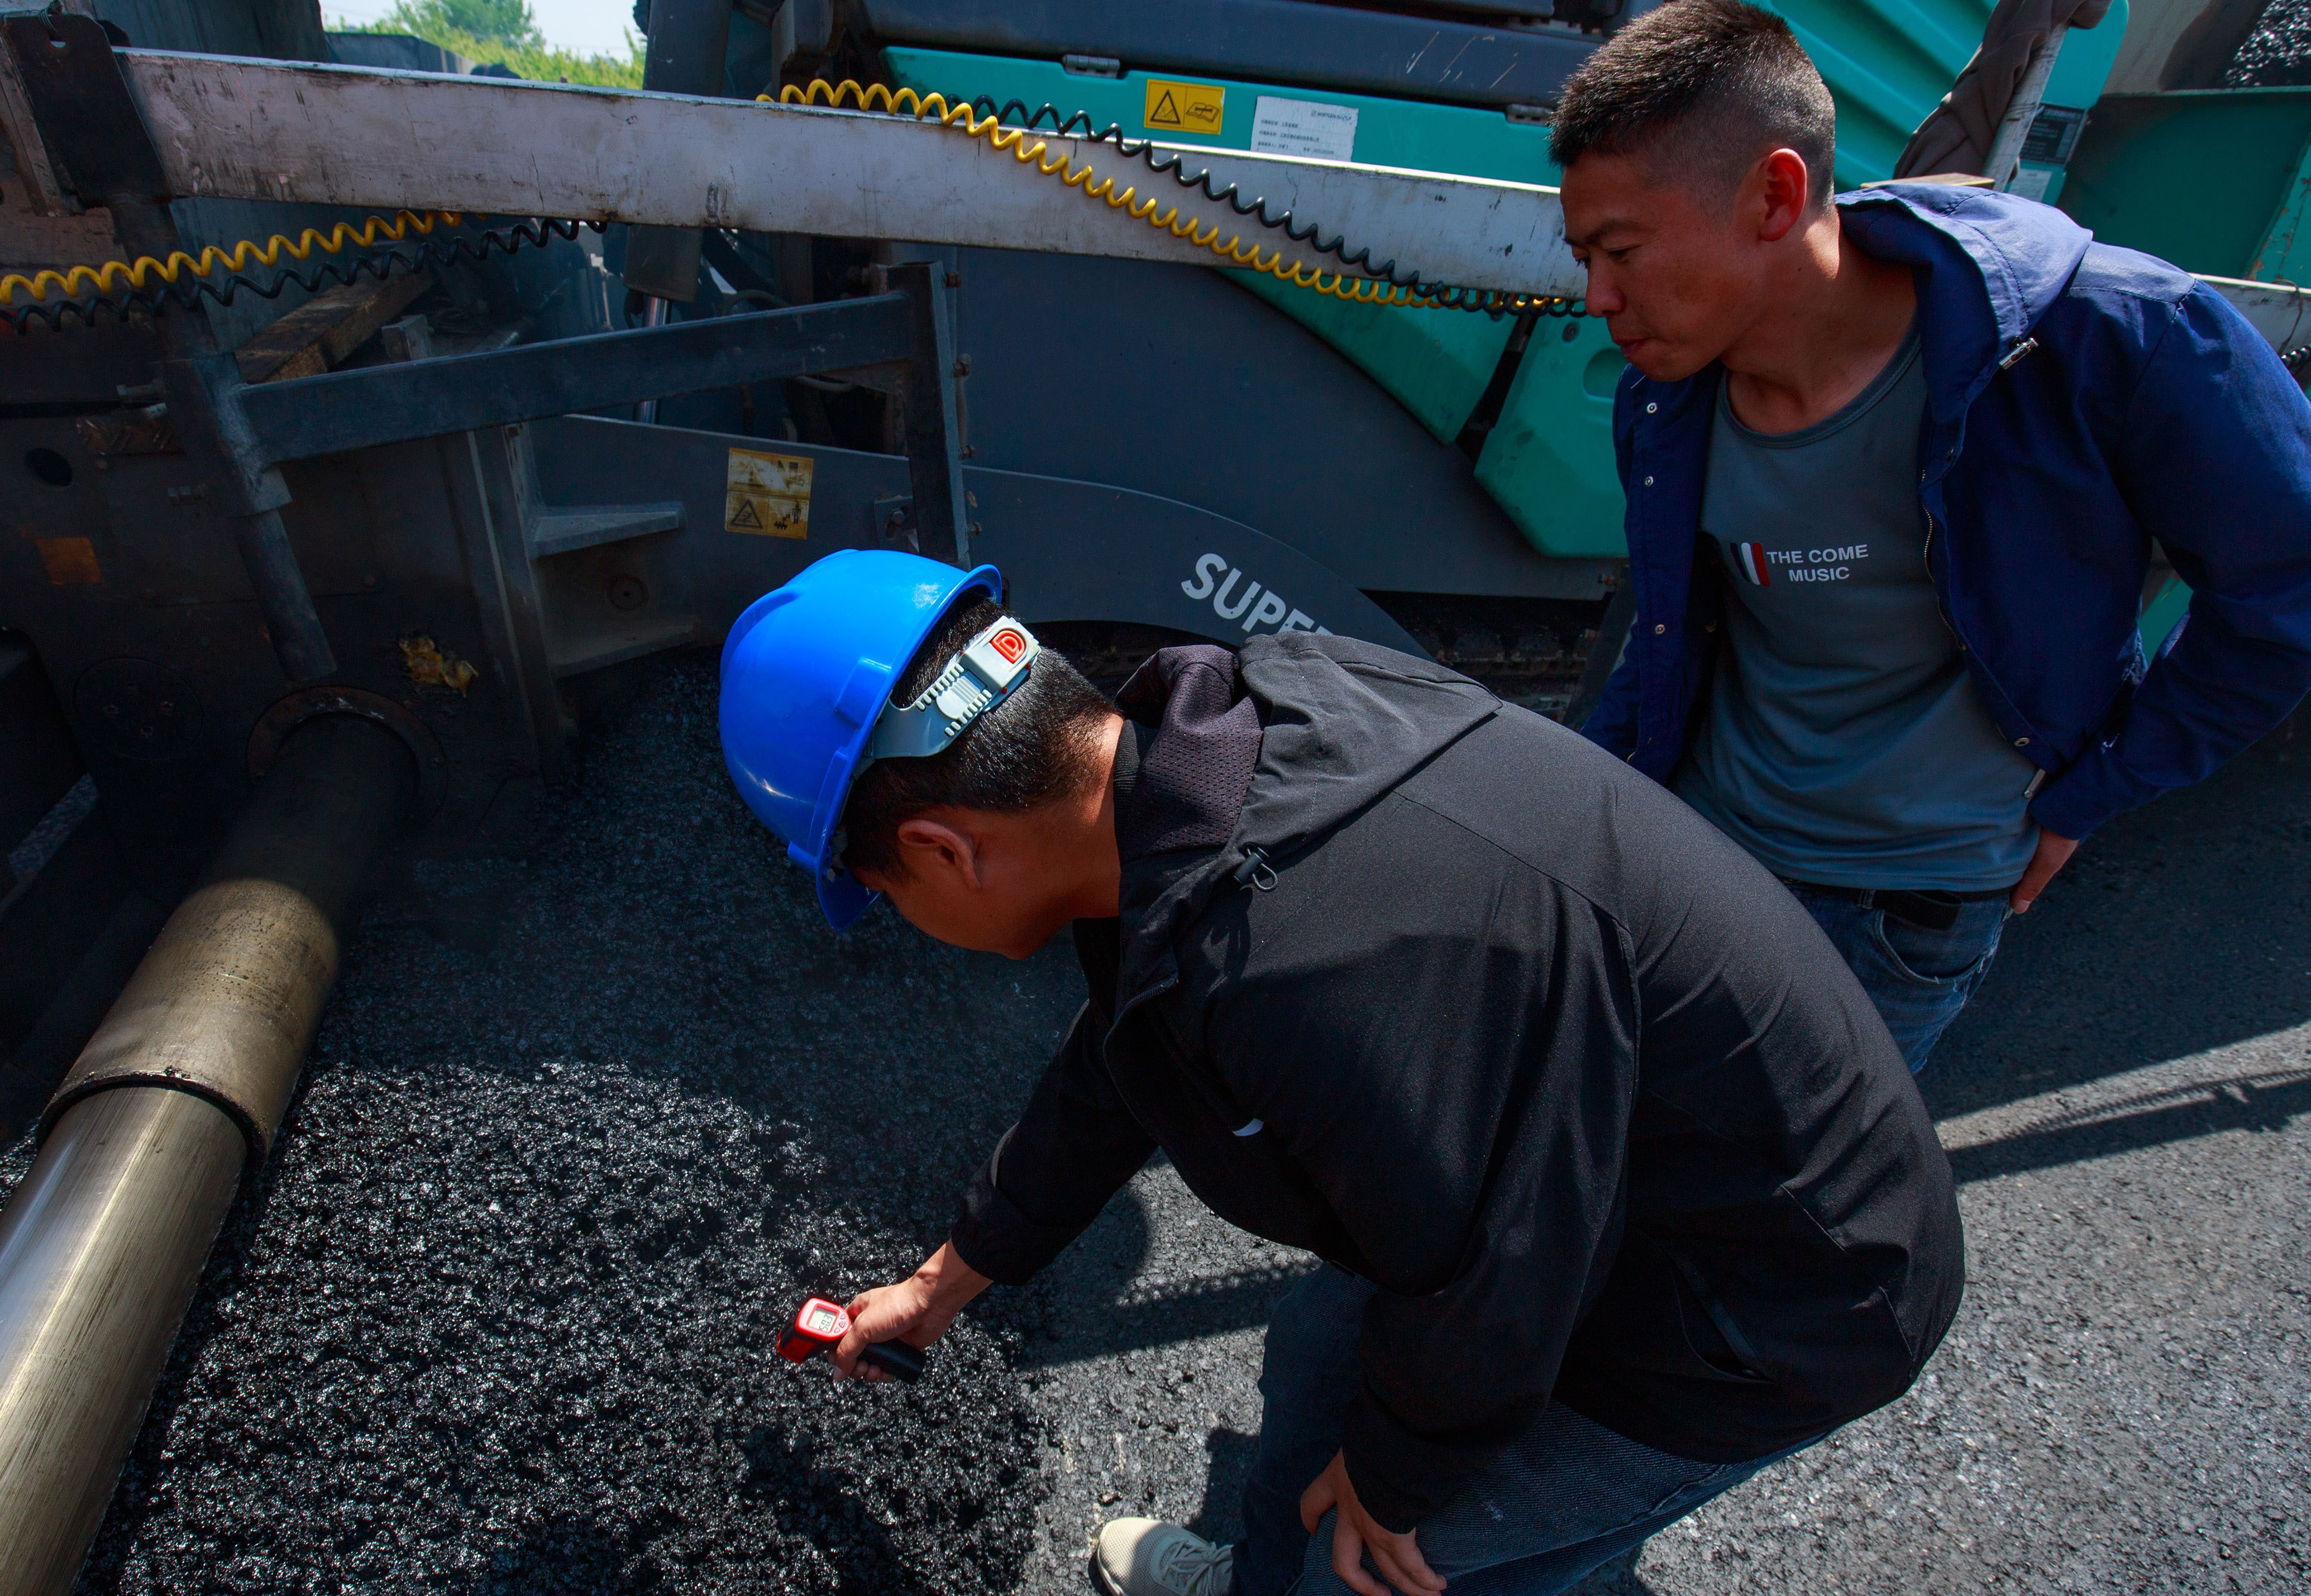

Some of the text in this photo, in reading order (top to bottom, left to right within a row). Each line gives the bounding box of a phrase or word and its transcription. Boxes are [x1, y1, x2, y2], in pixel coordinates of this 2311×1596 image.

[1767, 544, 1869, 564] THE COME
[1788, 567, 1850, 582] MUSIC
[1181, 553, 1334, 635] SUPE
